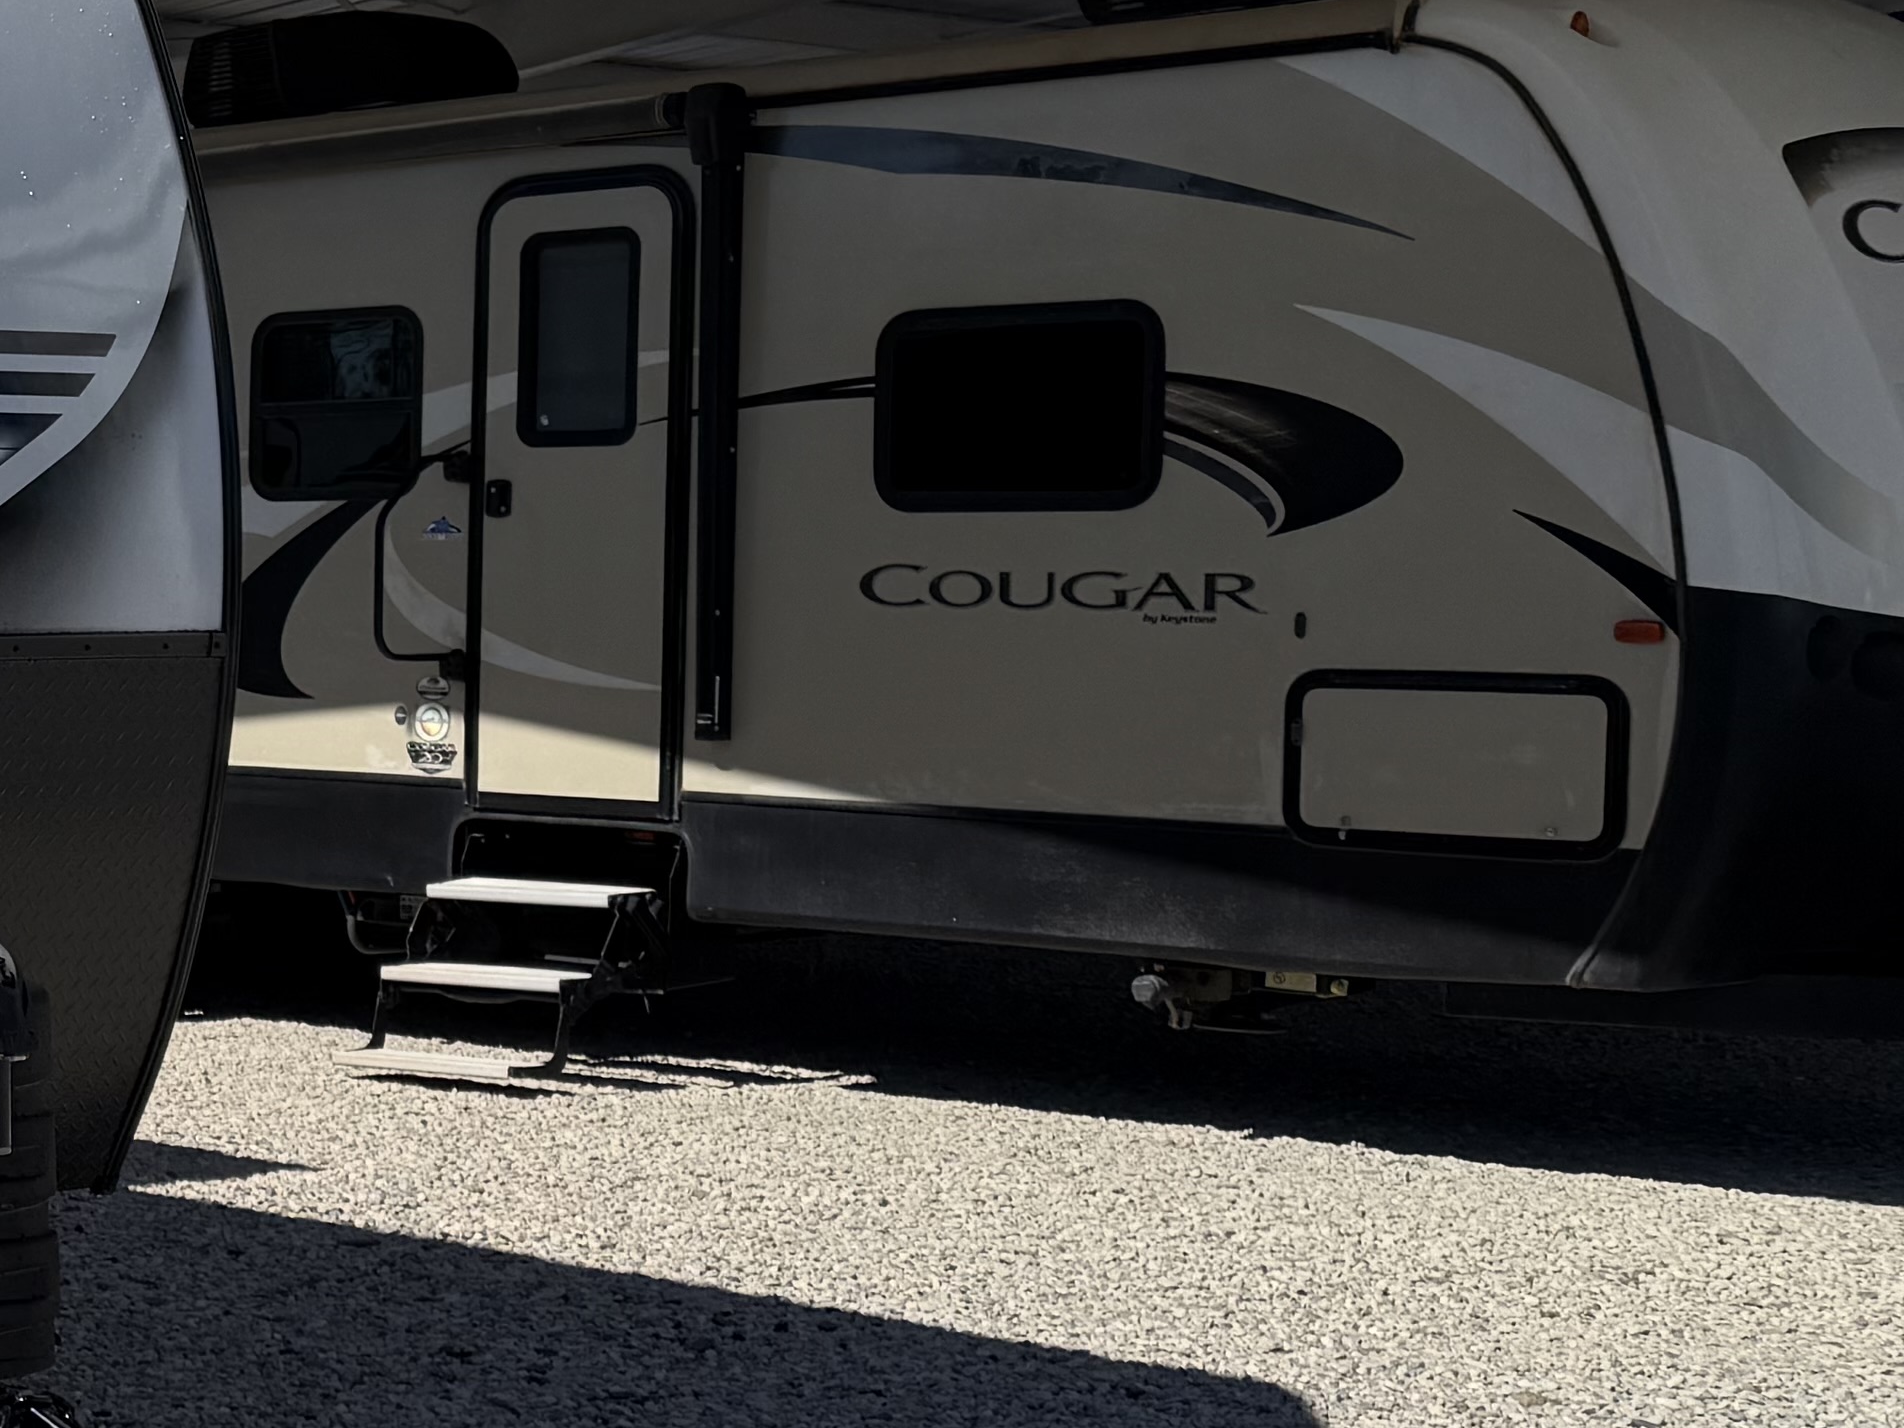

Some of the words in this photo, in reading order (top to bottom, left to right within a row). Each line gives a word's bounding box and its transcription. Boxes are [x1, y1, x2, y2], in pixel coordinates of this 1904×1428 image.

[859, 563, 1269, 615] COUGAR
[1143, 613, 1158, 624] by
[1160, 613, 1217, 625] Keystone
